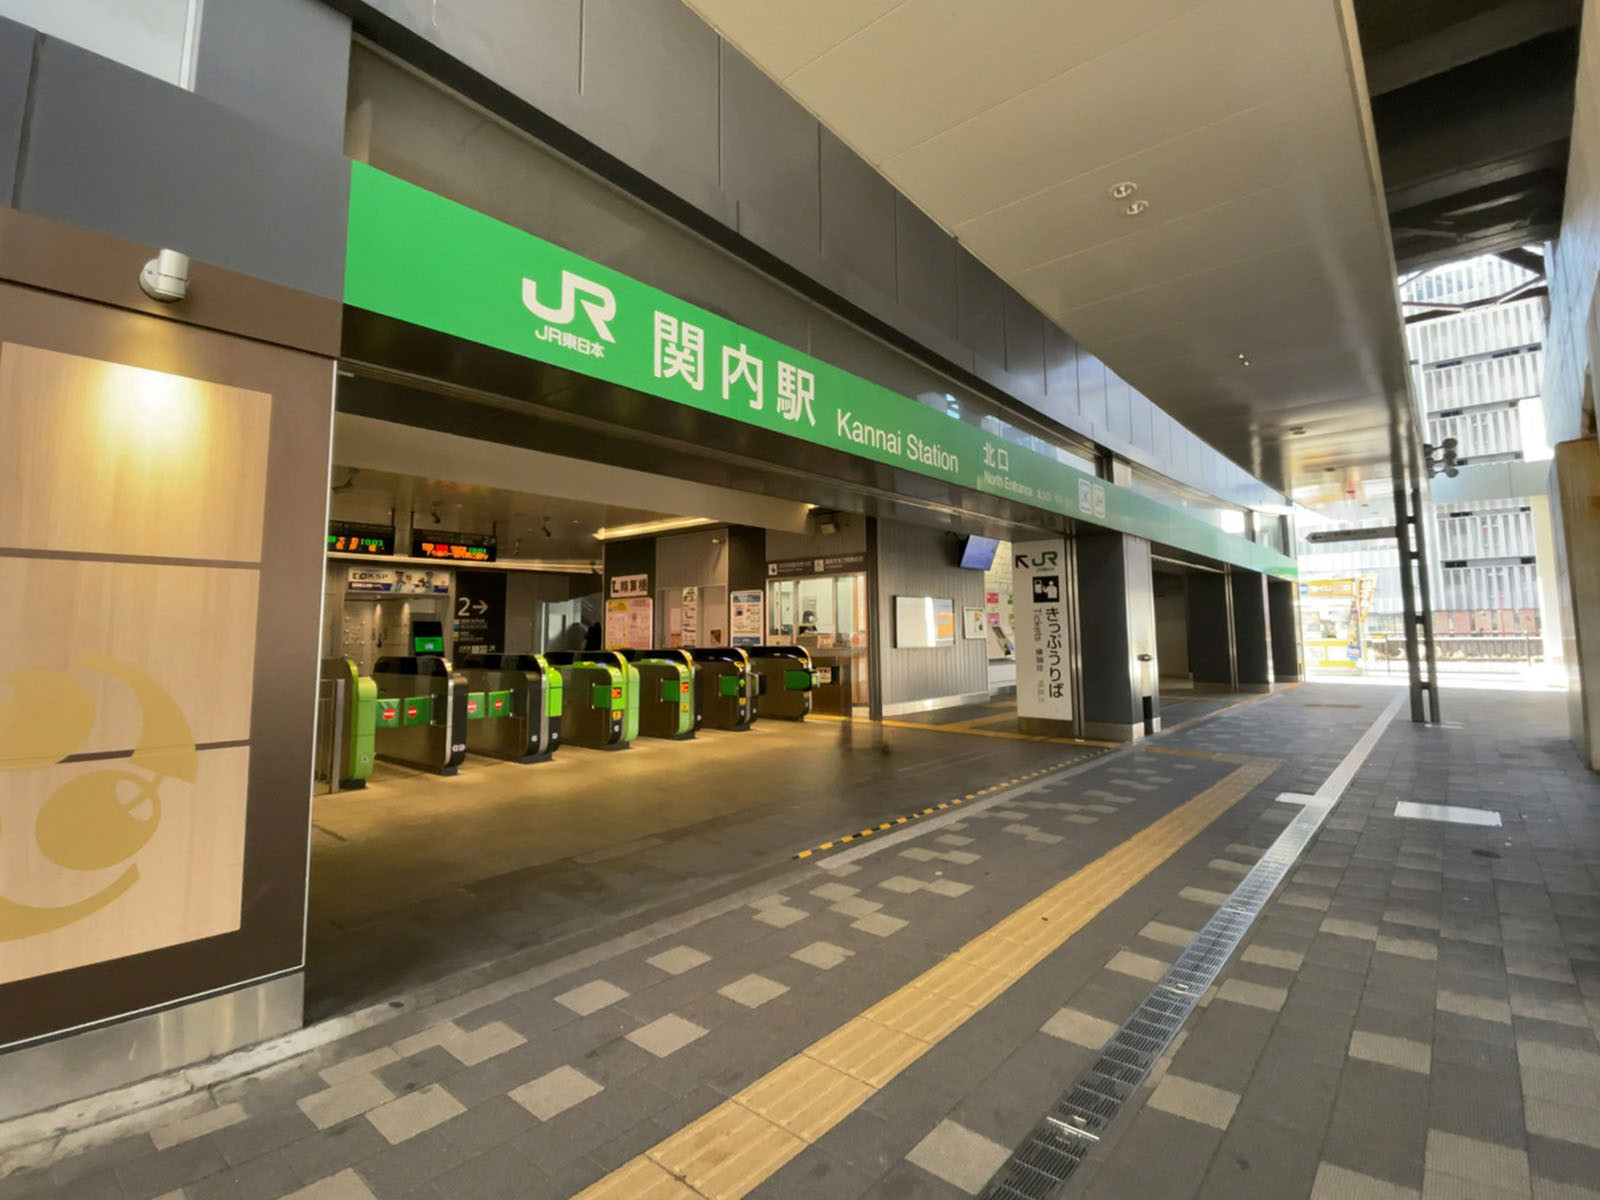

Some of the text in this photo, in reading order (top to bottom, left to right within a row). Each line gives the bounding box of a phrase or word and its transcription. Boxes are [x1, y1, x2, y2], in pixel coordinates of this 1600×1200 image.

[522, 270, 617, 344] JR
[535, 325, 605, 359] JR東日本
[654, 310, 817, 428] 関内駅
[837, 408, 959, 474] Kannai Station
[983, 441, 1009, 472] 北口
[983, 469, 1004, 489] North
[1005, 475, 1033, 497] Entrance
[1031, 550, 1058, 567] JR
[458, 596, 471, 616] 2
[1033, 608, 1043, 642] Tickets
[1045, 606, 1065, 698] きっぷうりば
